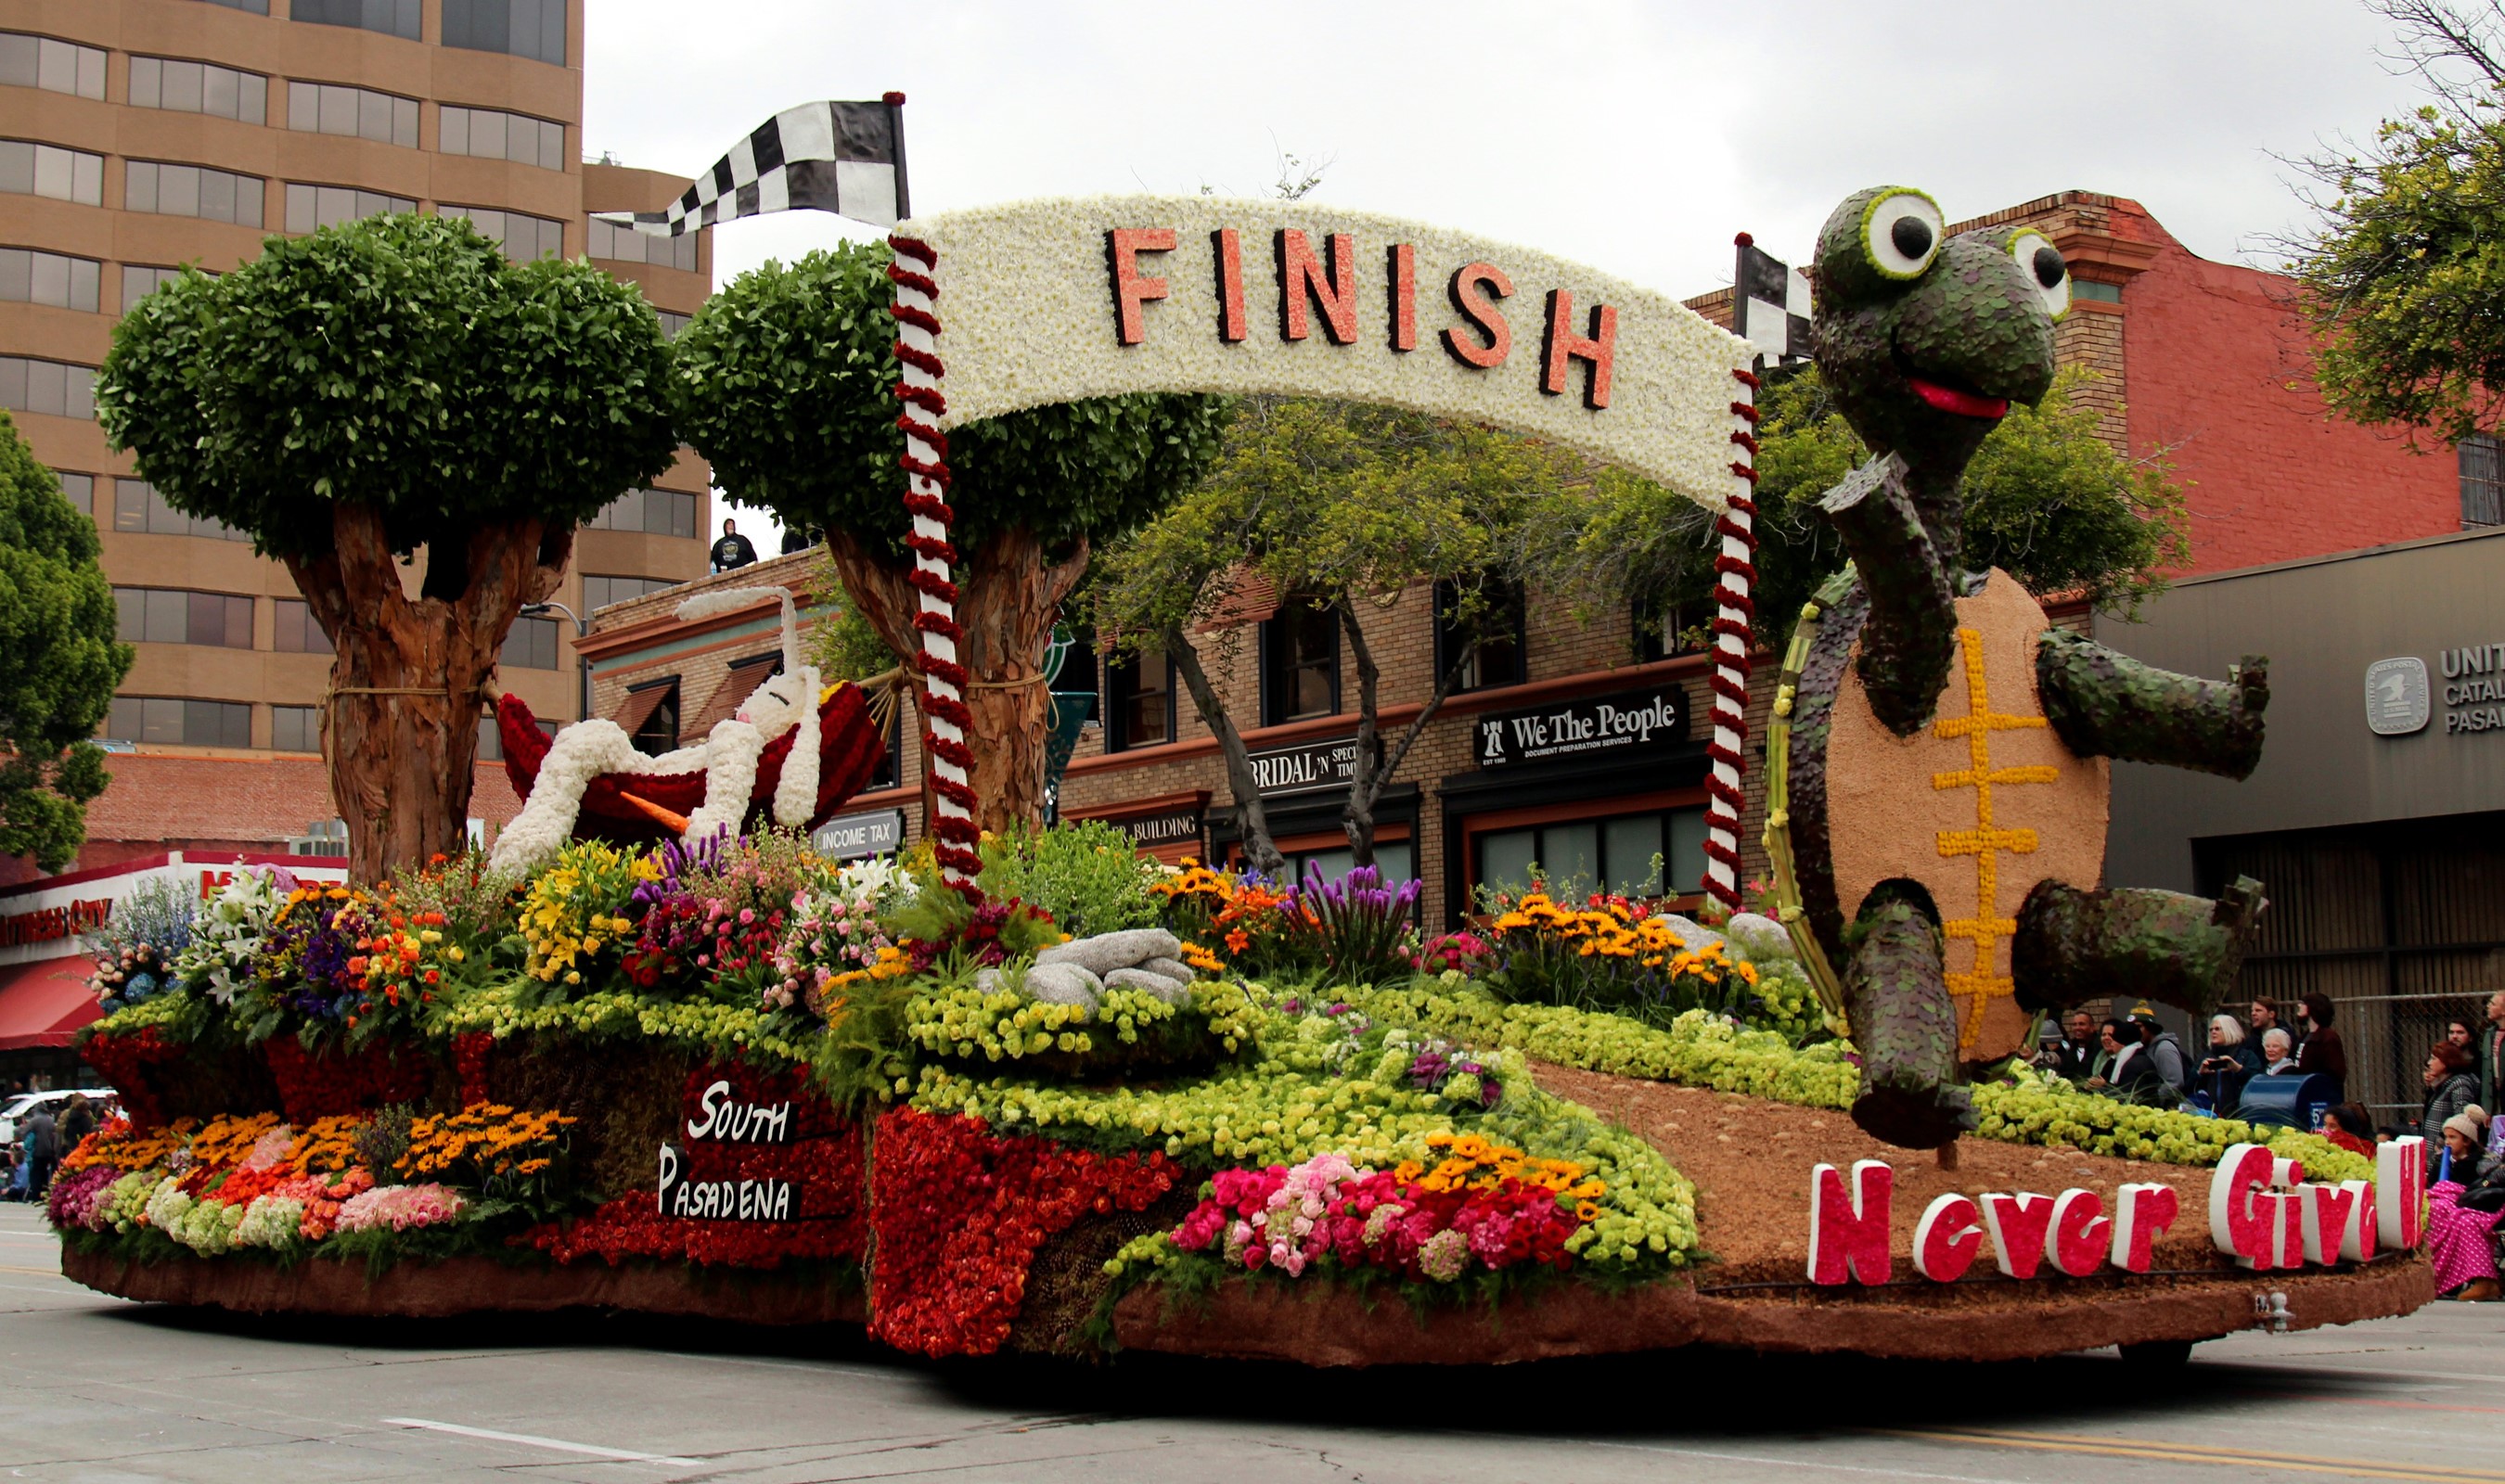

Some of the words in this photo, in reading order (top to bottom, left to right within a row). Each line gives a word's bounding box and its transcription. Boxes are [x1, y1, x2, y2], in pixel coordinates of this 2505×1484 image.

[1104, 227, 1618, 411] FINISH
[1511, 716, 1548, 748] We
[1548, 710, 1593, 743] The
[1596, 695, 1676, 742] People
[2445, 707, 2505, 734] PASA
[1331, 746, 1356, 762] SPECI
[1524, 747, 1559, 759] DOCUMENT
[1559, 740, 1601, 753] PREPARATION
[1602, 736, 1633, 747] SERVICES
[1250, 753, 1317, 787] BRIDAL
[1337, 761, 1356, 777] TIM
[823, 826, 866, 850] INCOME
[870, 823, 891, 843] TAX
[1134, 816, 1196, 841] BUILDING
[71, 898, 109, 935] CITY
[687, 1080, 790, 1143] SOUTH
[658, 1142, 790, 1221] PASADENA
[1807, 1158, 2178, 1287] Never
